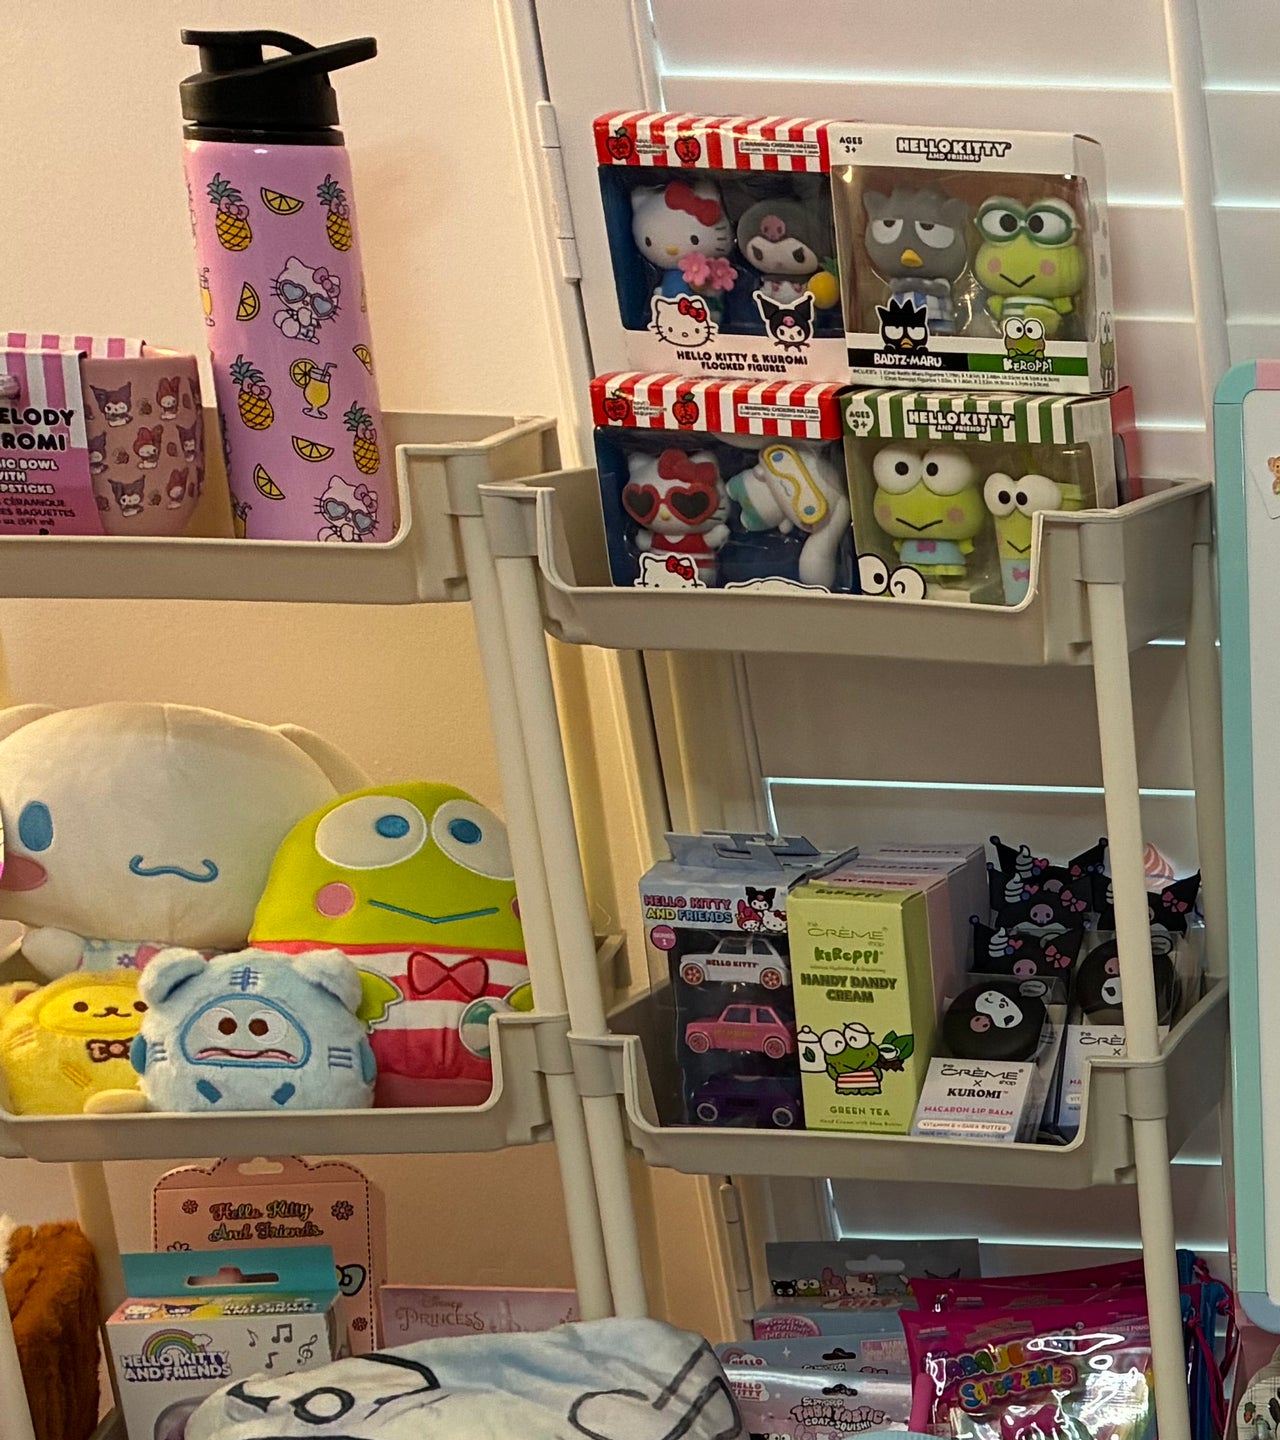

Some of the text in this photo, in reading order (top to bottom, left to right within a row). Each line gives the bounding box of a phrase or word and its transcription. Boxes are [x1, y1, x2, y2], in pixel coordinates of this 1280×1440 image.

[897, 138, 1010, 157] HELLO KITTY
[677, 351, 712, 361] HELLO
[715, 353, 748, 362] KITTY
[762, 355, 808, 365] KUROMI
[701, 362, 786, 372] FLOCKED FIGURES
[0, 408, 74, 426] ELODY
[2, 433, 66, 451] ROMI
[644, 895, 731, 911] HELLO KITTY
[647, 908, 733, 923] AND FRIENDS
[801, 973, 897, 990] HANDY DANDY
[826, 989, 874, 1003] CREAM
[947, 1088, 1004, 1099] KUROMI
[830, 1106, 890, 1116] GREEN TEA
[120, 1351, 229, 1368] HELLO KITTY
[125, 1364, 232, 1381] AND FRIENDS
